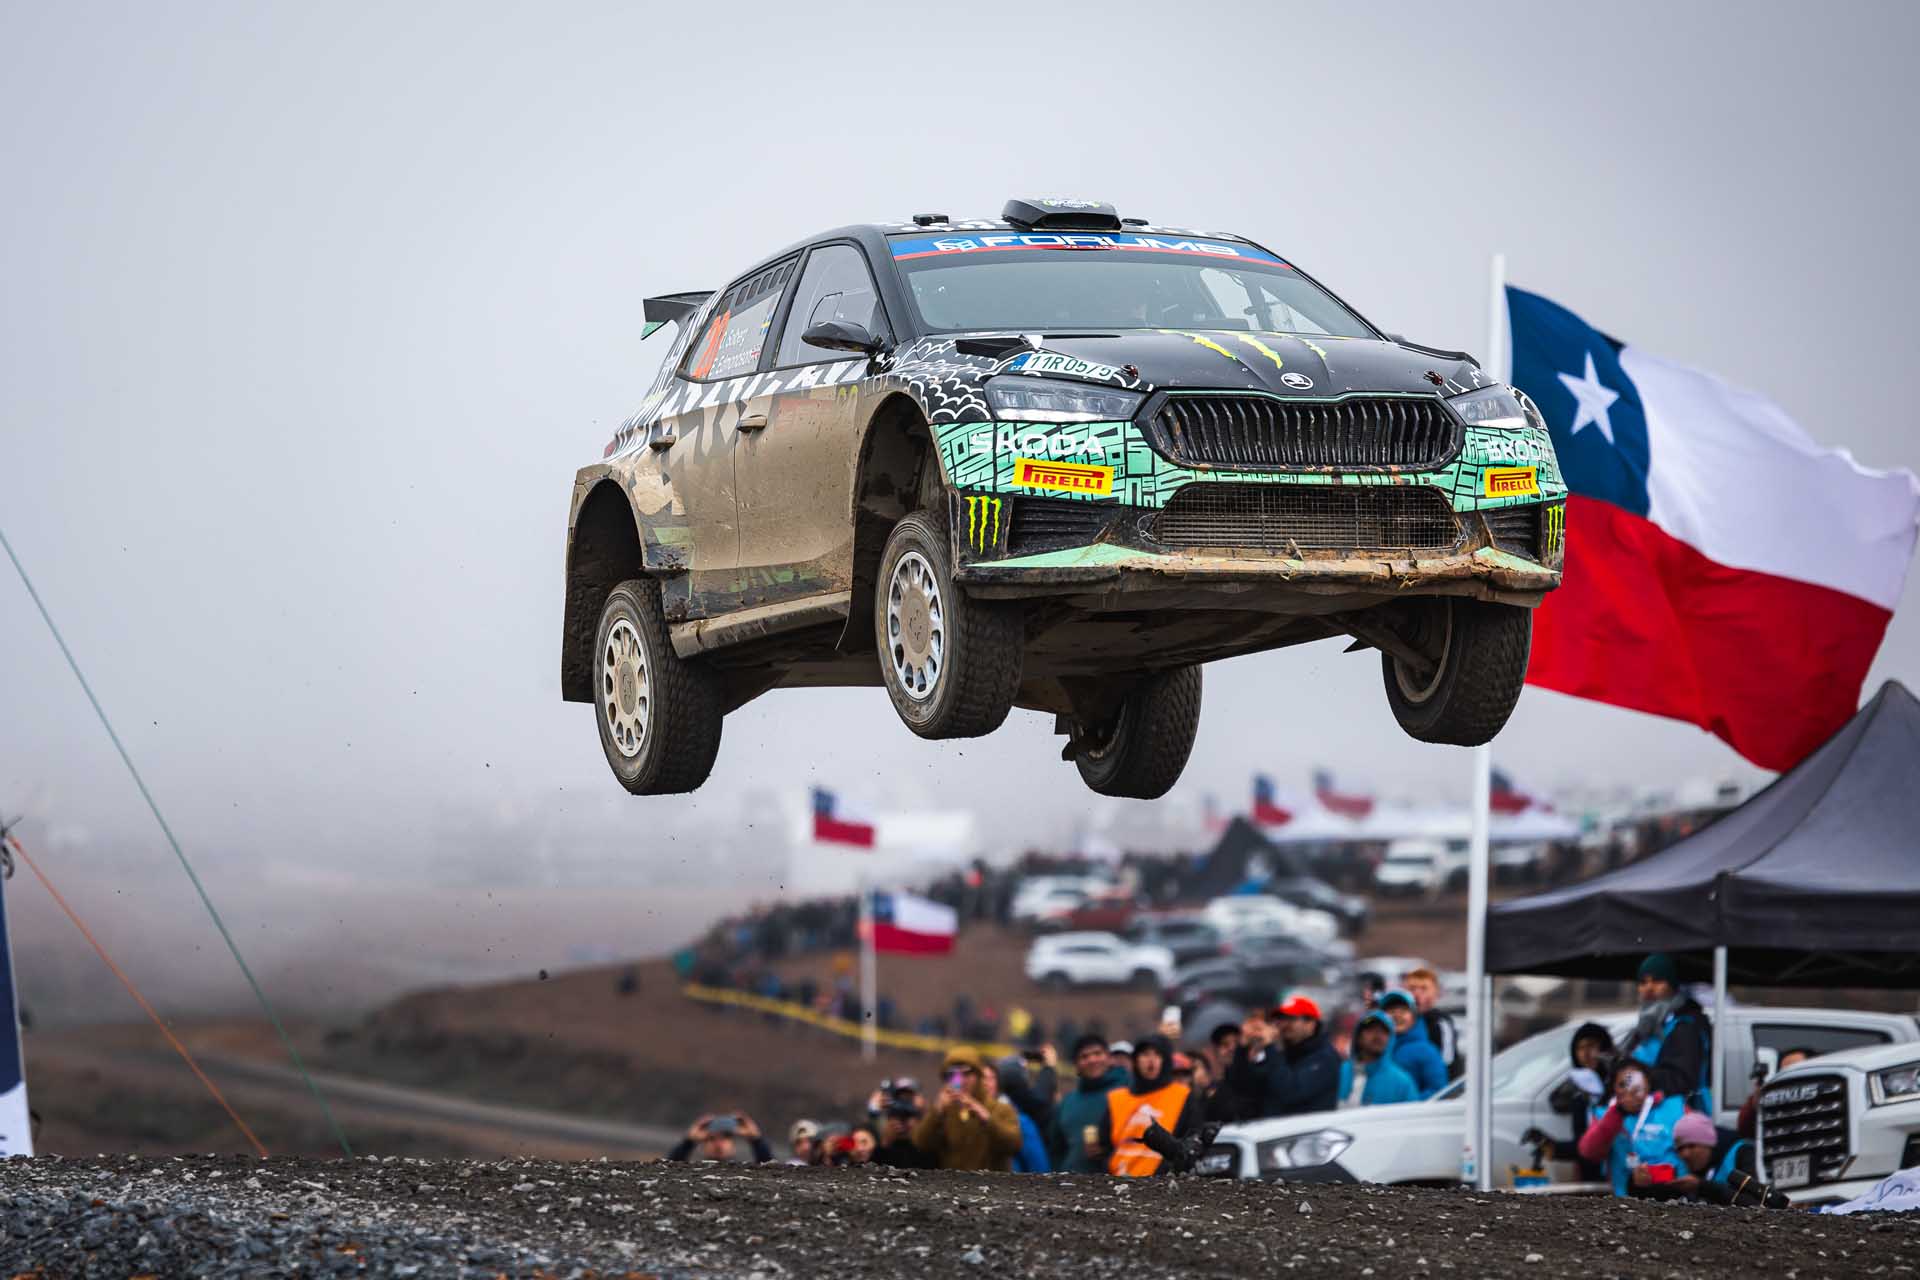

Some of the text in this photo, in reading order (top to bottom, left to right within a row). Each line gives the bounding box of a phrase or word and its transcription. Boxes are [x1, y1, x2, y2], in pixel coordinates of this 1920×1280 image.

[1030, 355, 1064, 371] 11R
[1023, 464, 1105, 489] PIRELLI
[1490, 472, 1533, 492] PIRELLI
